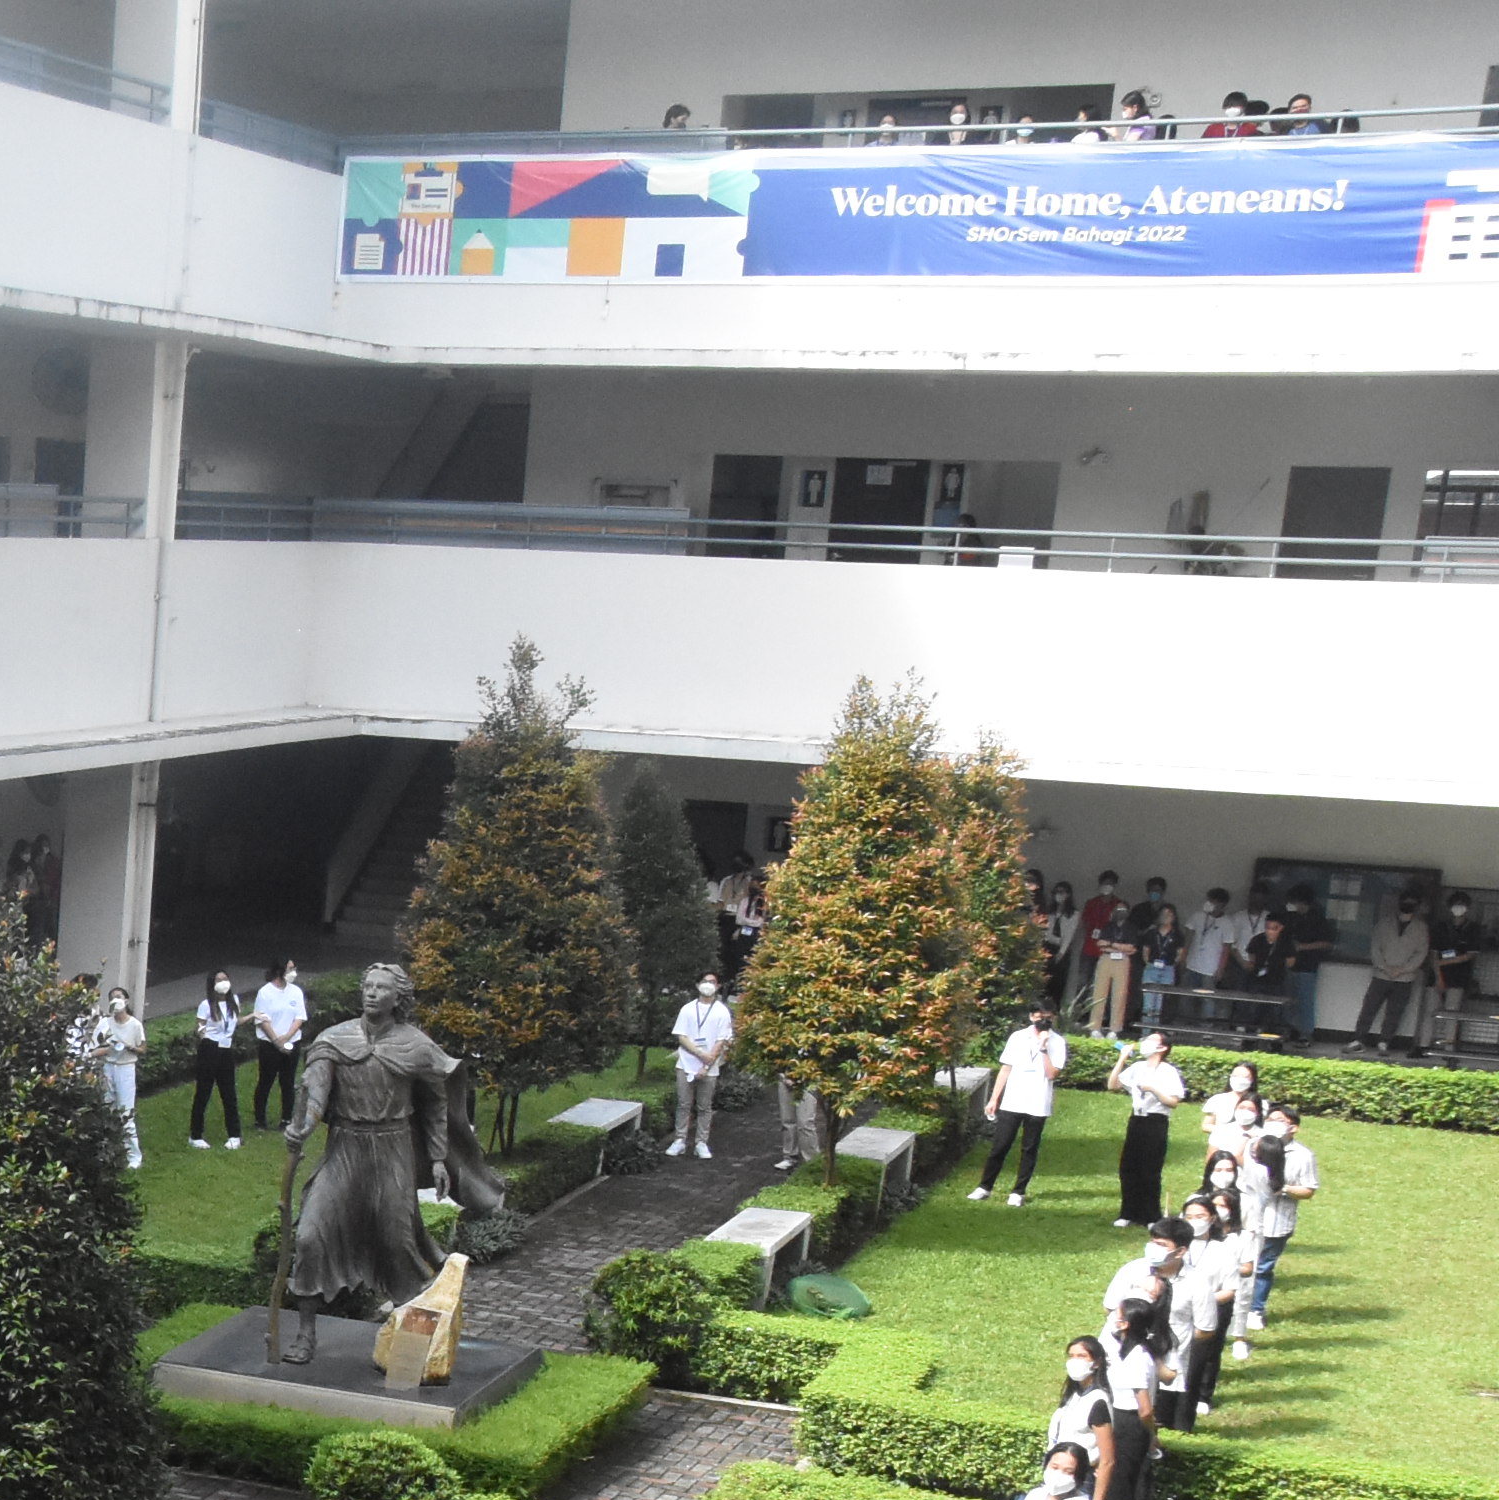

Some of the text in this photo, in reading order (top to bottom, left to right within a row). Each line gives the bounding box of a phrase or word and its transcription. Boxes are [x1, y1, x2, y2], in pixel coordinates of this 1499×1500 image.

[831, 179, 1350, 220] Welcome Home, Ateneans!
[966, 225, 1187, 246] SHOrSem Bahagi 2022
